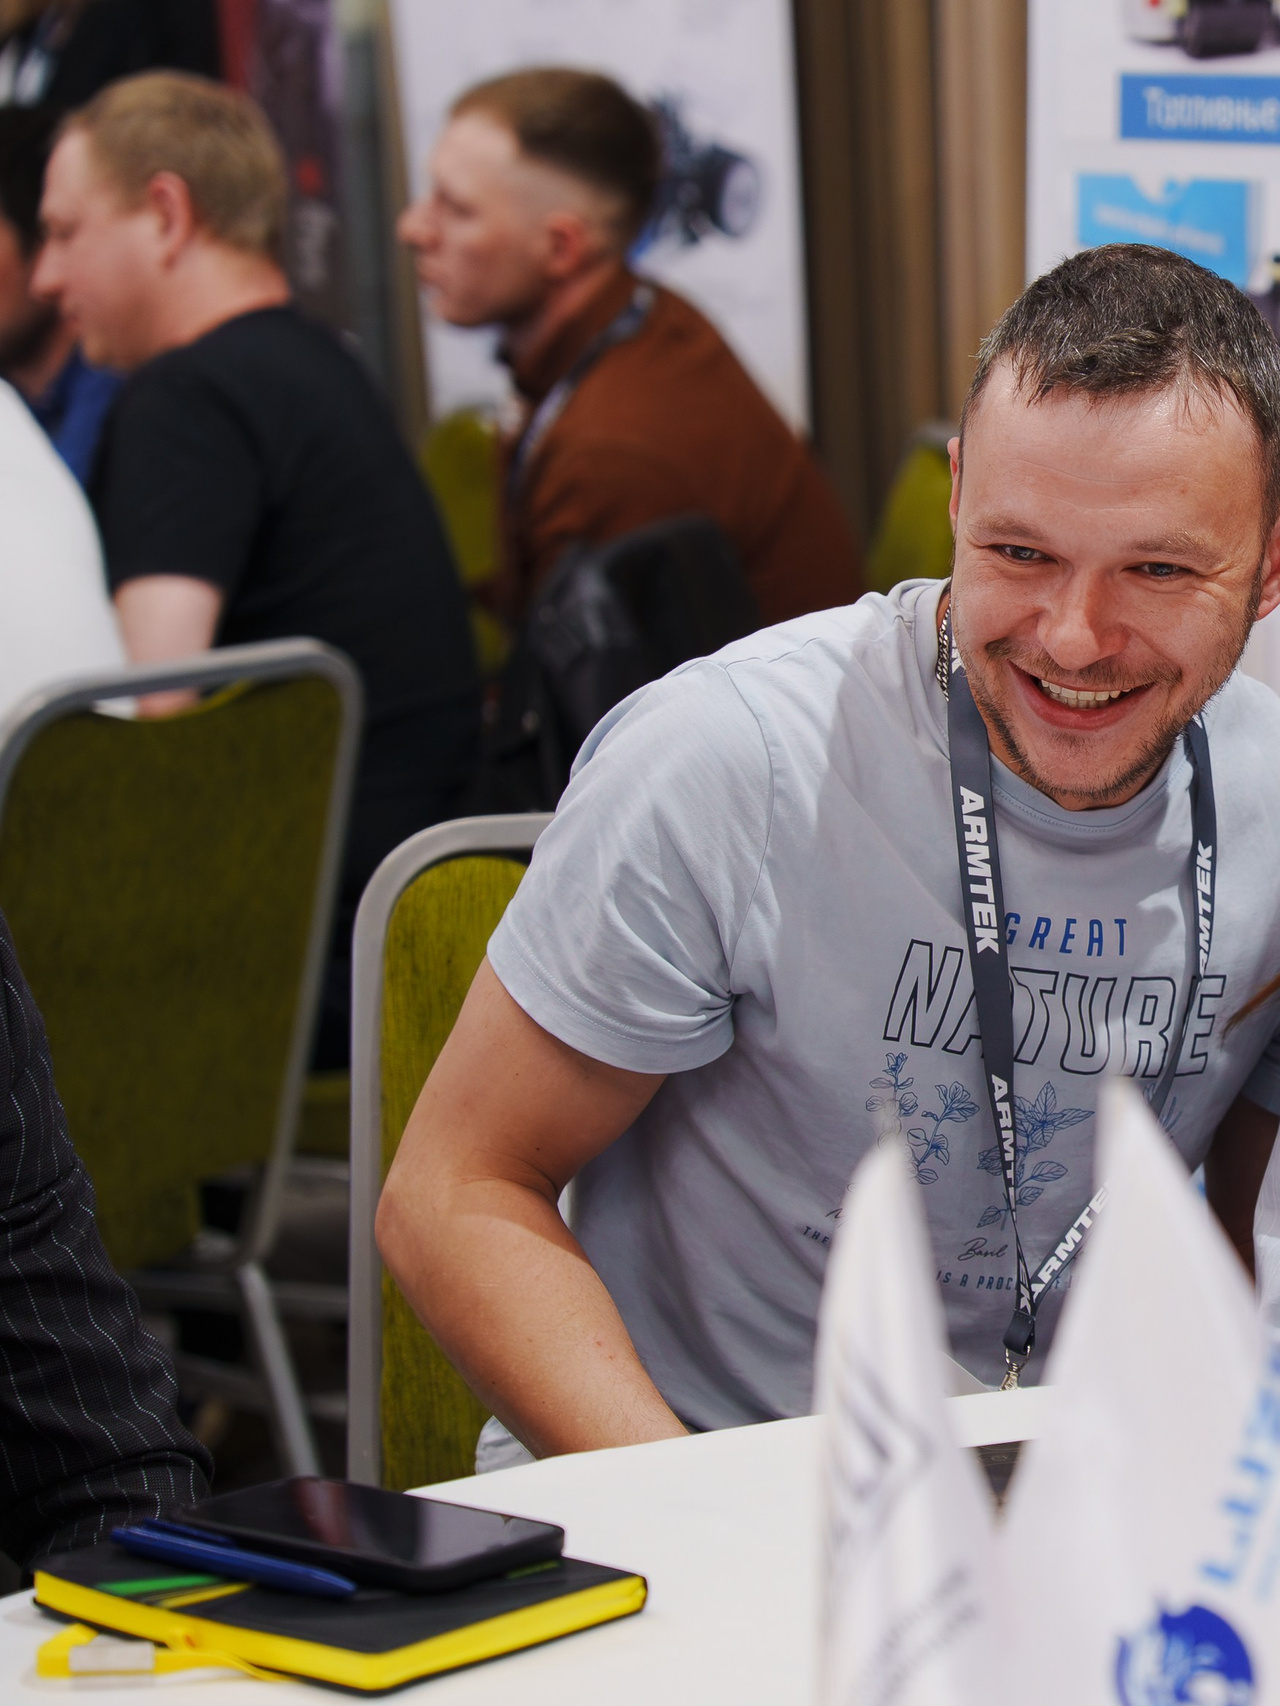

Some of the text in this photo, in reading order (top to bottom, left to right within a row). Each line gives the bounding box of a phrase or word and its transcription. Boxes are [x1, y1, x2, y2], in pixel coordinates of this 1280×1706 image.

[960, 785, 999, 955] ARMTEK
[1196, 840, 1213, 978] RMTEK
[1004, 912, 1127, 957] GREAT
[959, 1274, 969, 1288] A
[976, 1275, 1018, 1291] PROC
[1032, 1184, 1110, 1303] ARMTE
